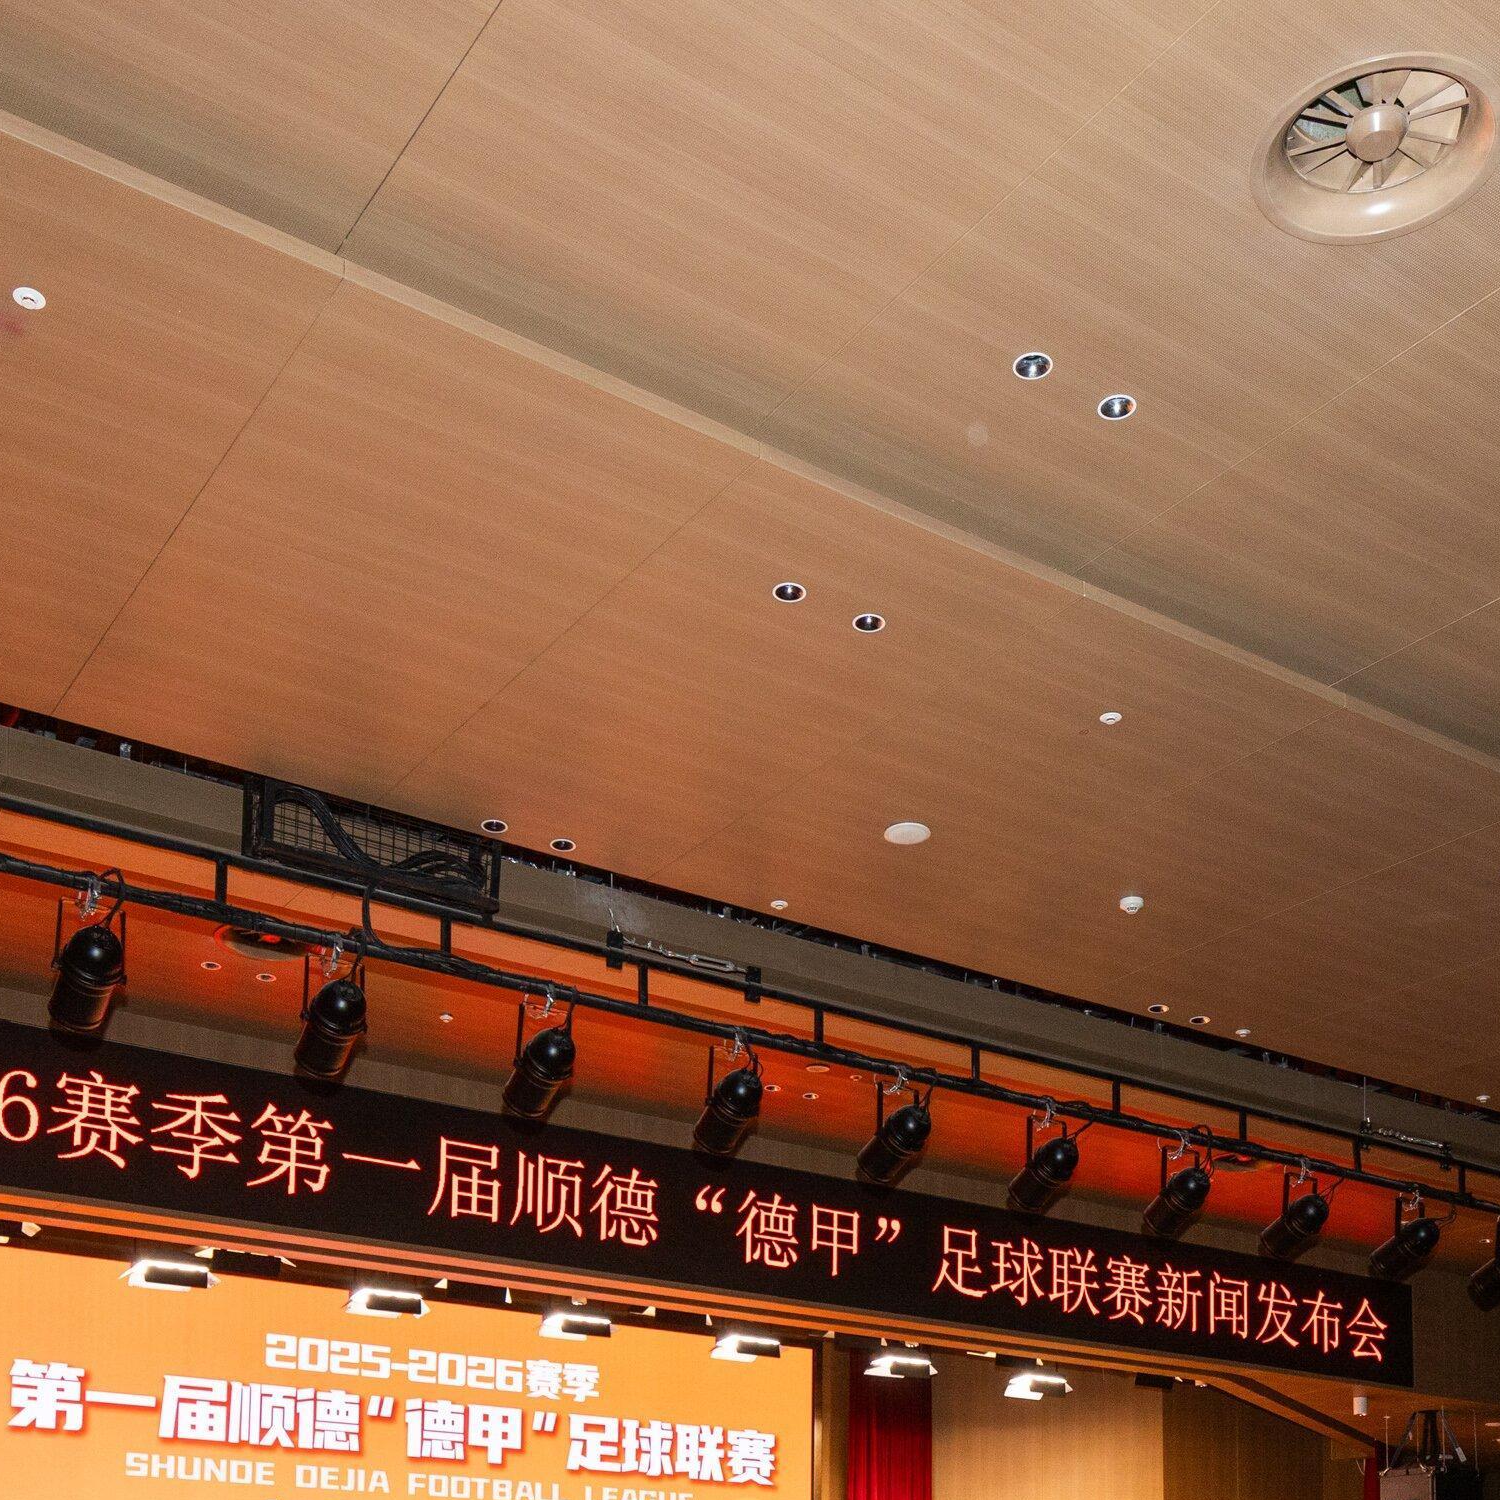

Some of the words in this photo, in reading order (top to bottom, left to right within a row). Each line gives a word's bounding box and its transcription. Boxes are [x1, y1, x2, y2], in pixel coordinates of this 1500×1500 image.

[266, 1333, 601, 1402] 2025-2026赛季
[125, 1453, 275, 1485] SHUNDE
[295, 1464, 390, 1494] DEJIA
